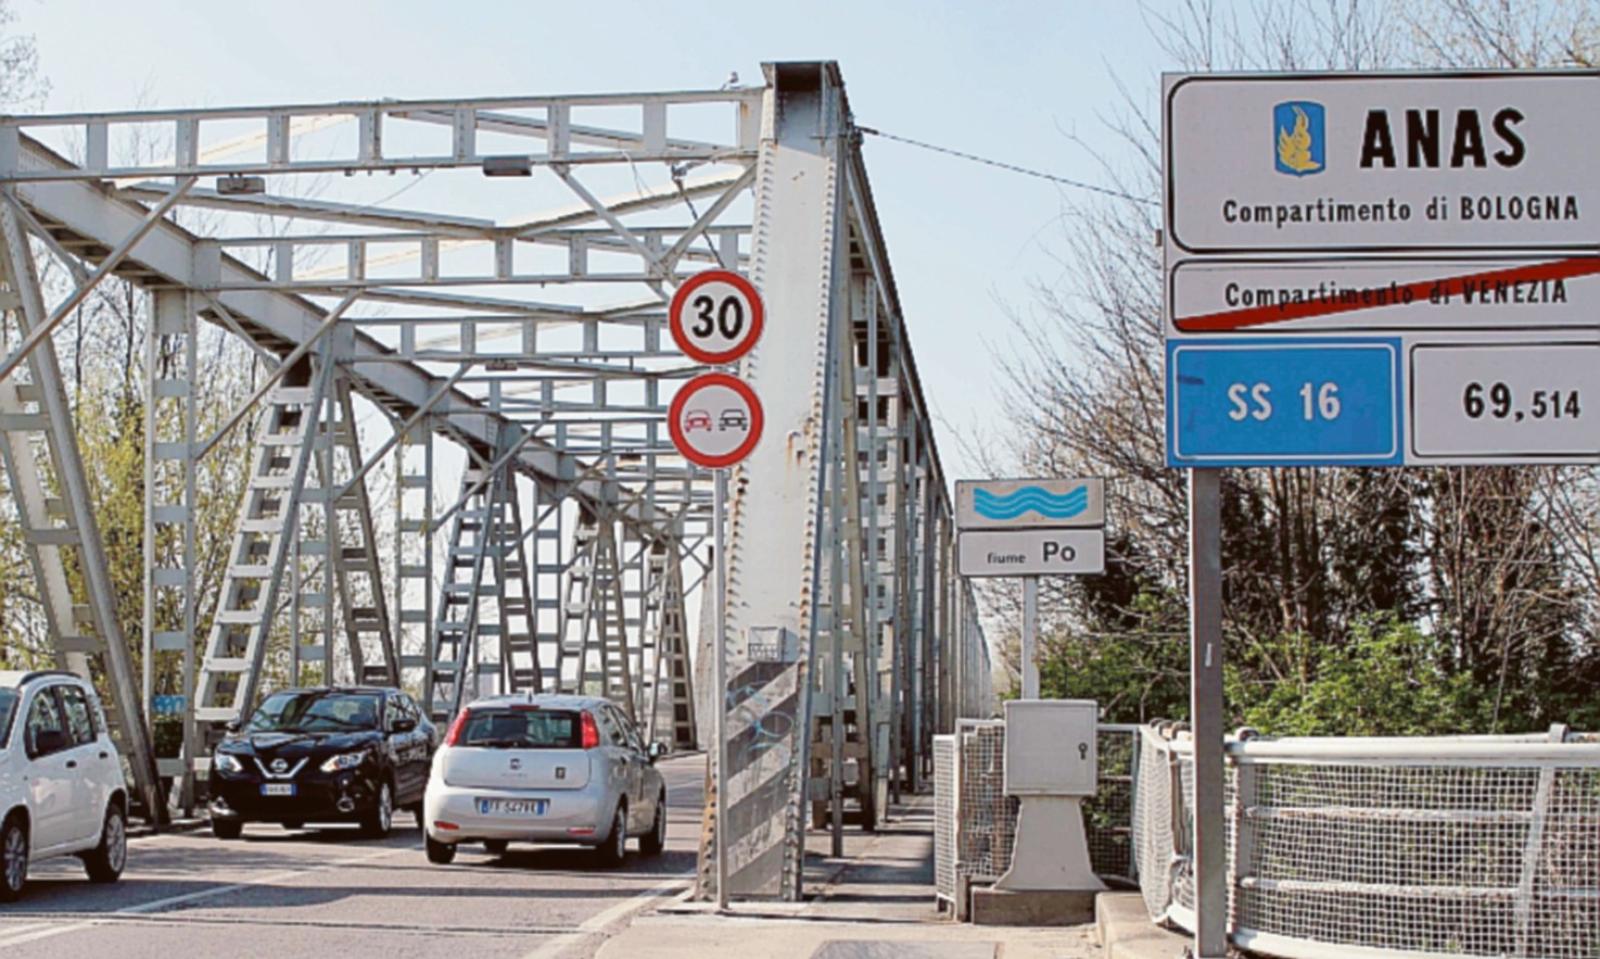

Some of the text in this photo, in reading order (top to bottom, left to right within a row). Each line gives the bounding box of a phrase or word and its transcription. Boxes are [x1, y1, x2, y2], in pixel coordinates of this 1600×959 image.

[1360, 108, 1526, 168] ANAS
[1223, 195, 1579, 229] Compartimento di BOLOGNA
[1225, 278, 1567, 312] Compartimento di VENEZIA
[692, 295, 744, 340] 30
[1228, 382, 1340, 421] SS 16
[1464, 382, 1581, 422] 69,514
[987, 541, 1076, 564] fiume Po
